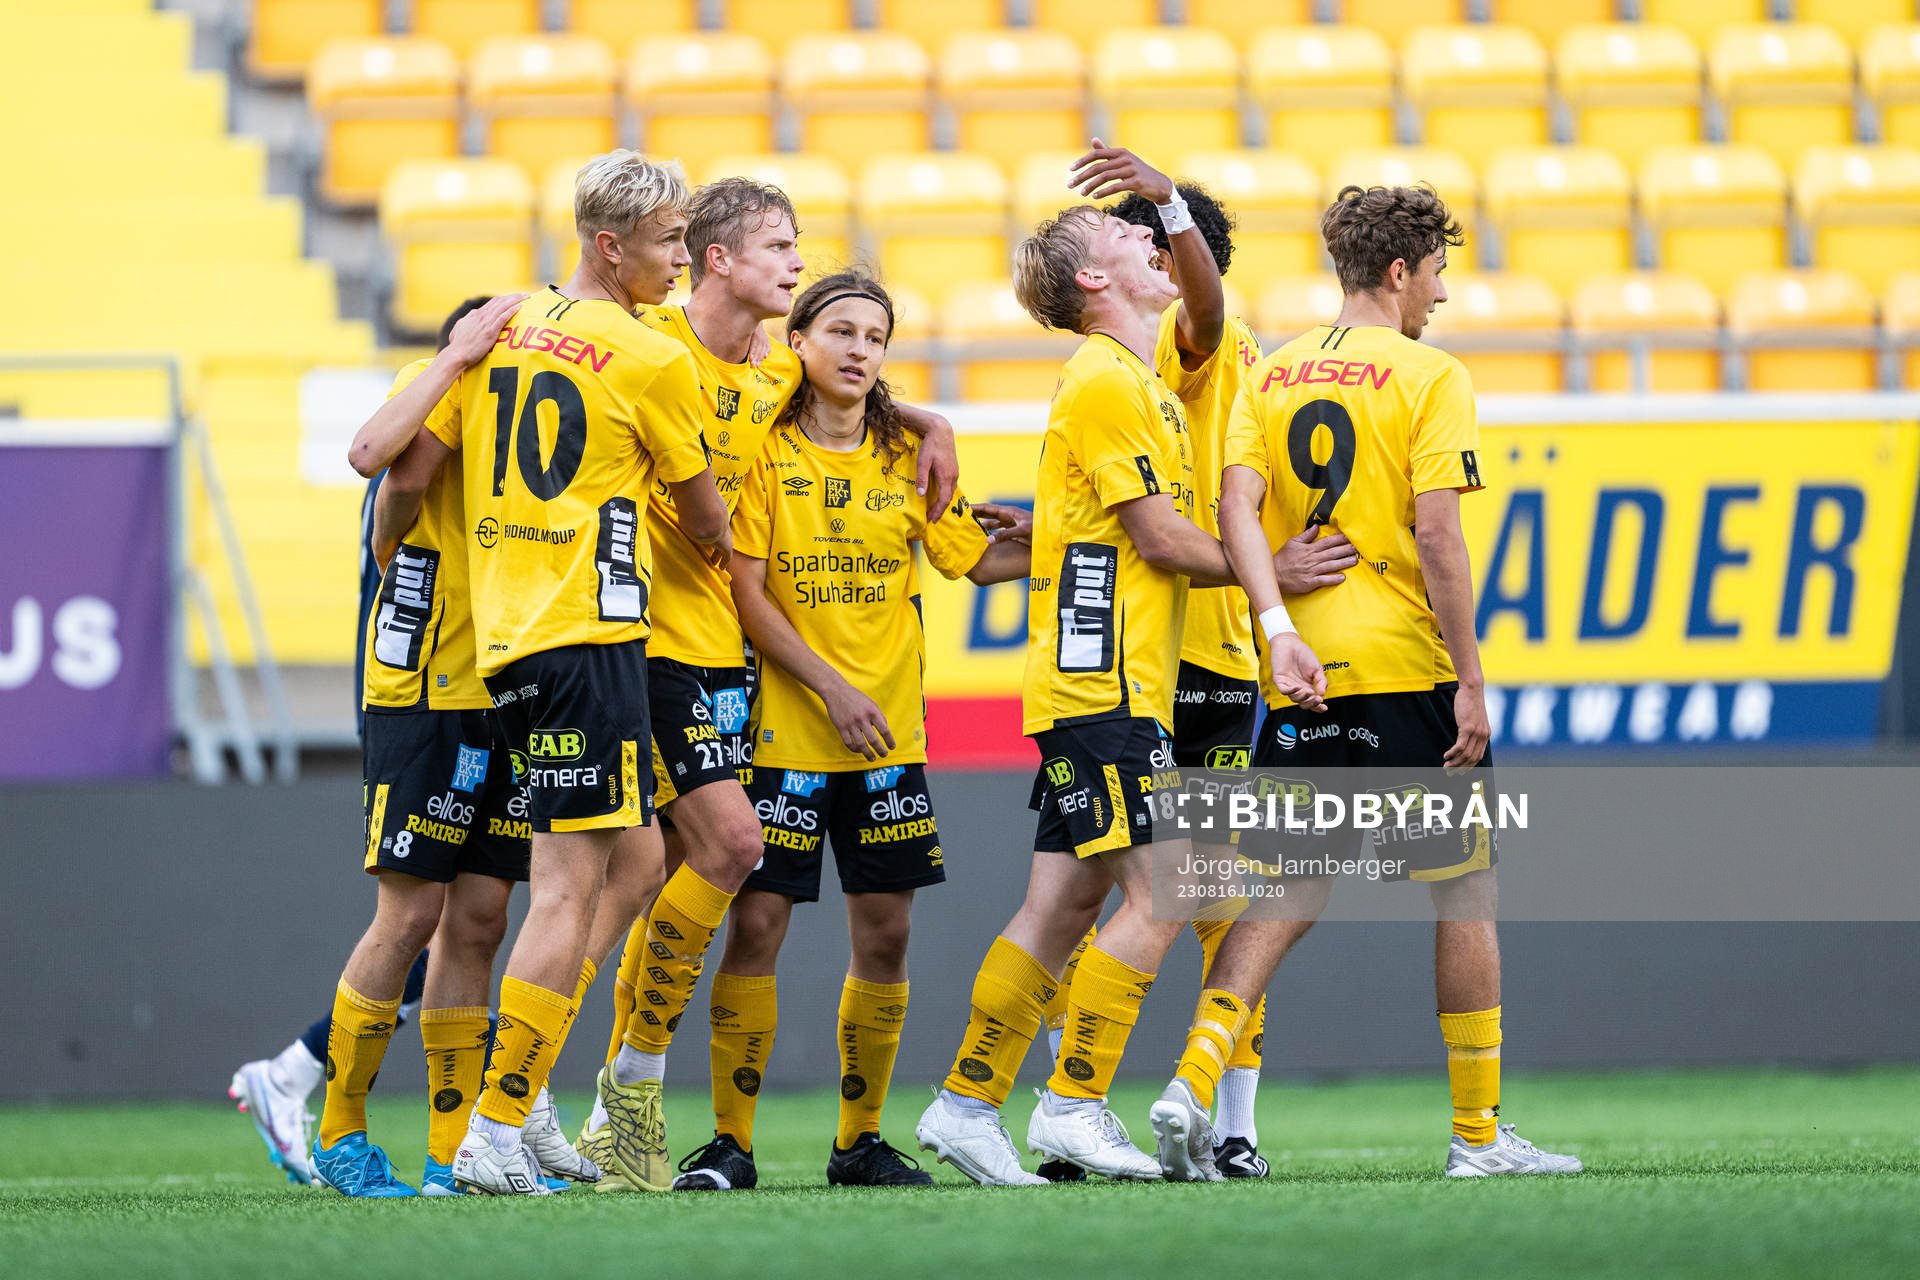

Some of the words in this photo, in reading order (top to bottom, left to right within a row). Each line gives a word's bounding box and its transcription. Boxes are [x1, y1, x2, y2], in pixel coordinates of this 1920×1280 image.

[1260, 359, 1392, 393] PULSEN
[488, 366, 587, 502] 10
[1288, 399, 1357, 531] 9
[785, 489, 810, 497] umbro
[827, 478, 847, 490] EFF
[827, 488, 850, 499] EKT
[827, 497, 841, 507] IV
[813, 536, 851, 544] TOVEKS
[777, 550, 900, 578] Sparbanken
[795, 581, 886, 609] Sjuhärad
[493, 689, 518, 707] LAND
[458, 746, 482, 765] EFF
[529, 733, 581, 757] EAB
[694, 741, 724, 770] 27
[457, 760, 484, 779] EKT
[1213, 750, 1250, 771] EA
[454, 773, 470, 788] IV
[530, 766, 599, 788] ernera
[607, 774, 617, 805] umbro
[785, 776, 806, 793] IV
[427, 791, 475, 825] ellos
[755, 794, 818, 831] ellos
[871, 790, 929, 821] ellos
[1092, 796, 1104, 828] umbro
[1143, 791, 1176, 822] 18
[763, 825, 821, 852] MIRENT
[858, 816, 938, 844] RAMIREN
[392, 830, 414, 859] 8
[1075, 1010, 1099, 1056] VINN
[518, 1038, 544, 1073] VINN
[843, 1024, 858, 1072] VINNE
[443, 1049, 457, 1086] VINN
